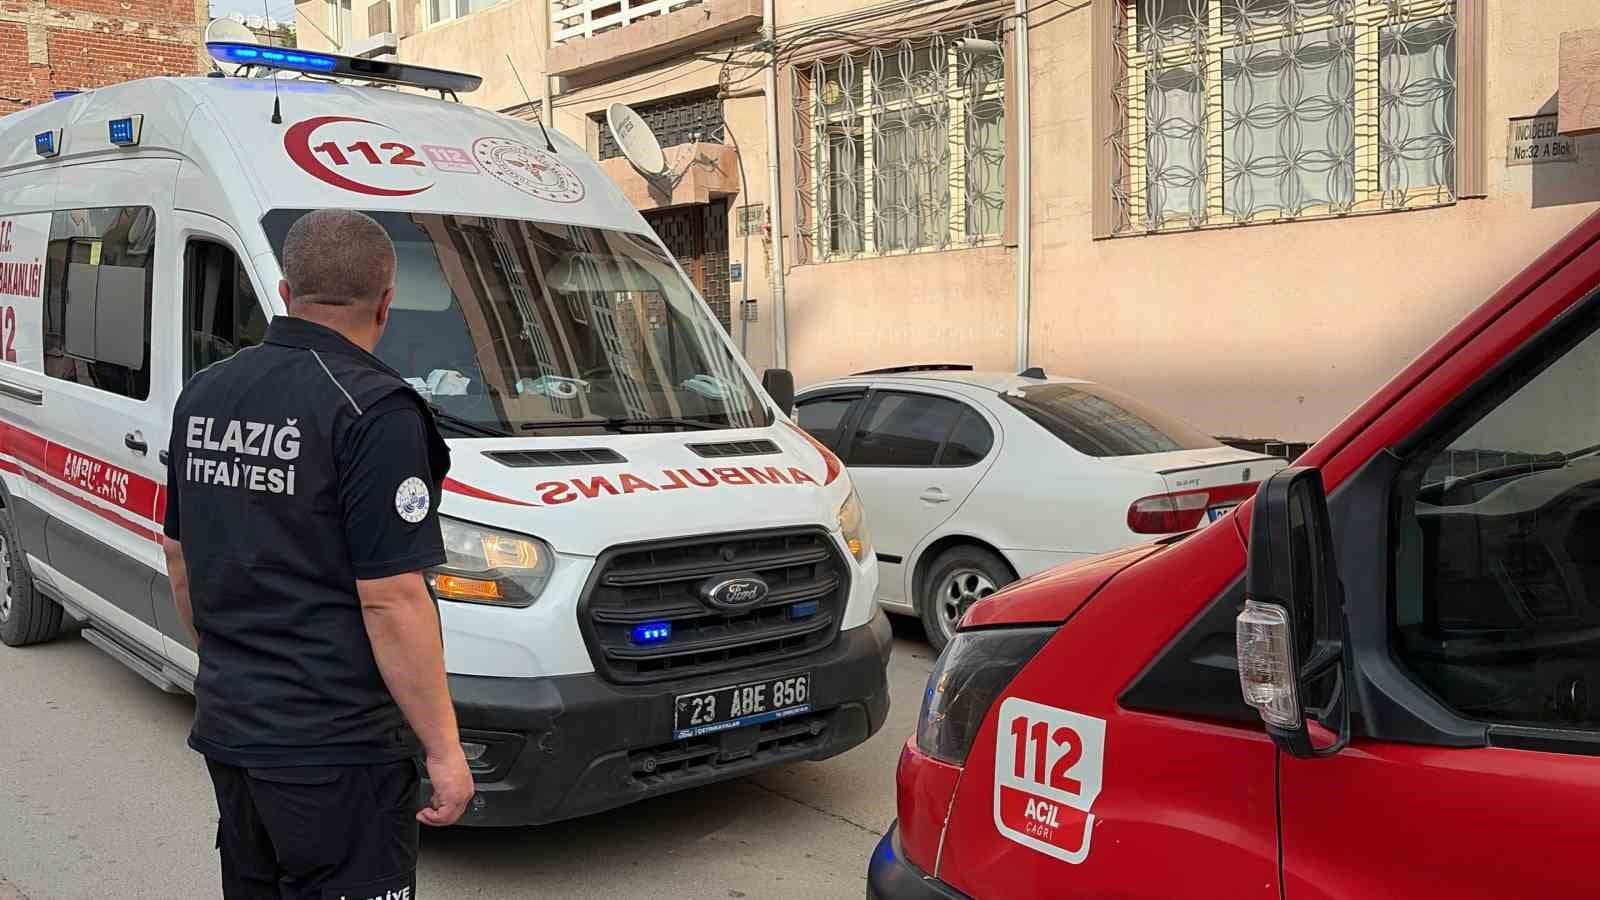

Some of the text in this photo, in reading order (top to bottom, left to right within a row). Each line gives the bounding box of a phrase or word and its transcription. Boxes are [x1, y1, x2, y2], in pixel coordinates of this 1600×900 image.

[313, 141, 426, 167] 112
[429, 149, 469, 162] 112
[1514, 144, 1539, 160] No:32
[1543, 143, 1550, 157] A
[186, 415, 301, 460] ELAZIĞ
[187, 452, 295, 496] İTFAİYESİ
[726, 583, 758, 602] Ford
[690, 695, 715, 725] 23
[730, 684, 766, 718] ABE
[773, 677, 806, 707] 856
[1011, 716, 1083, 796] 112
